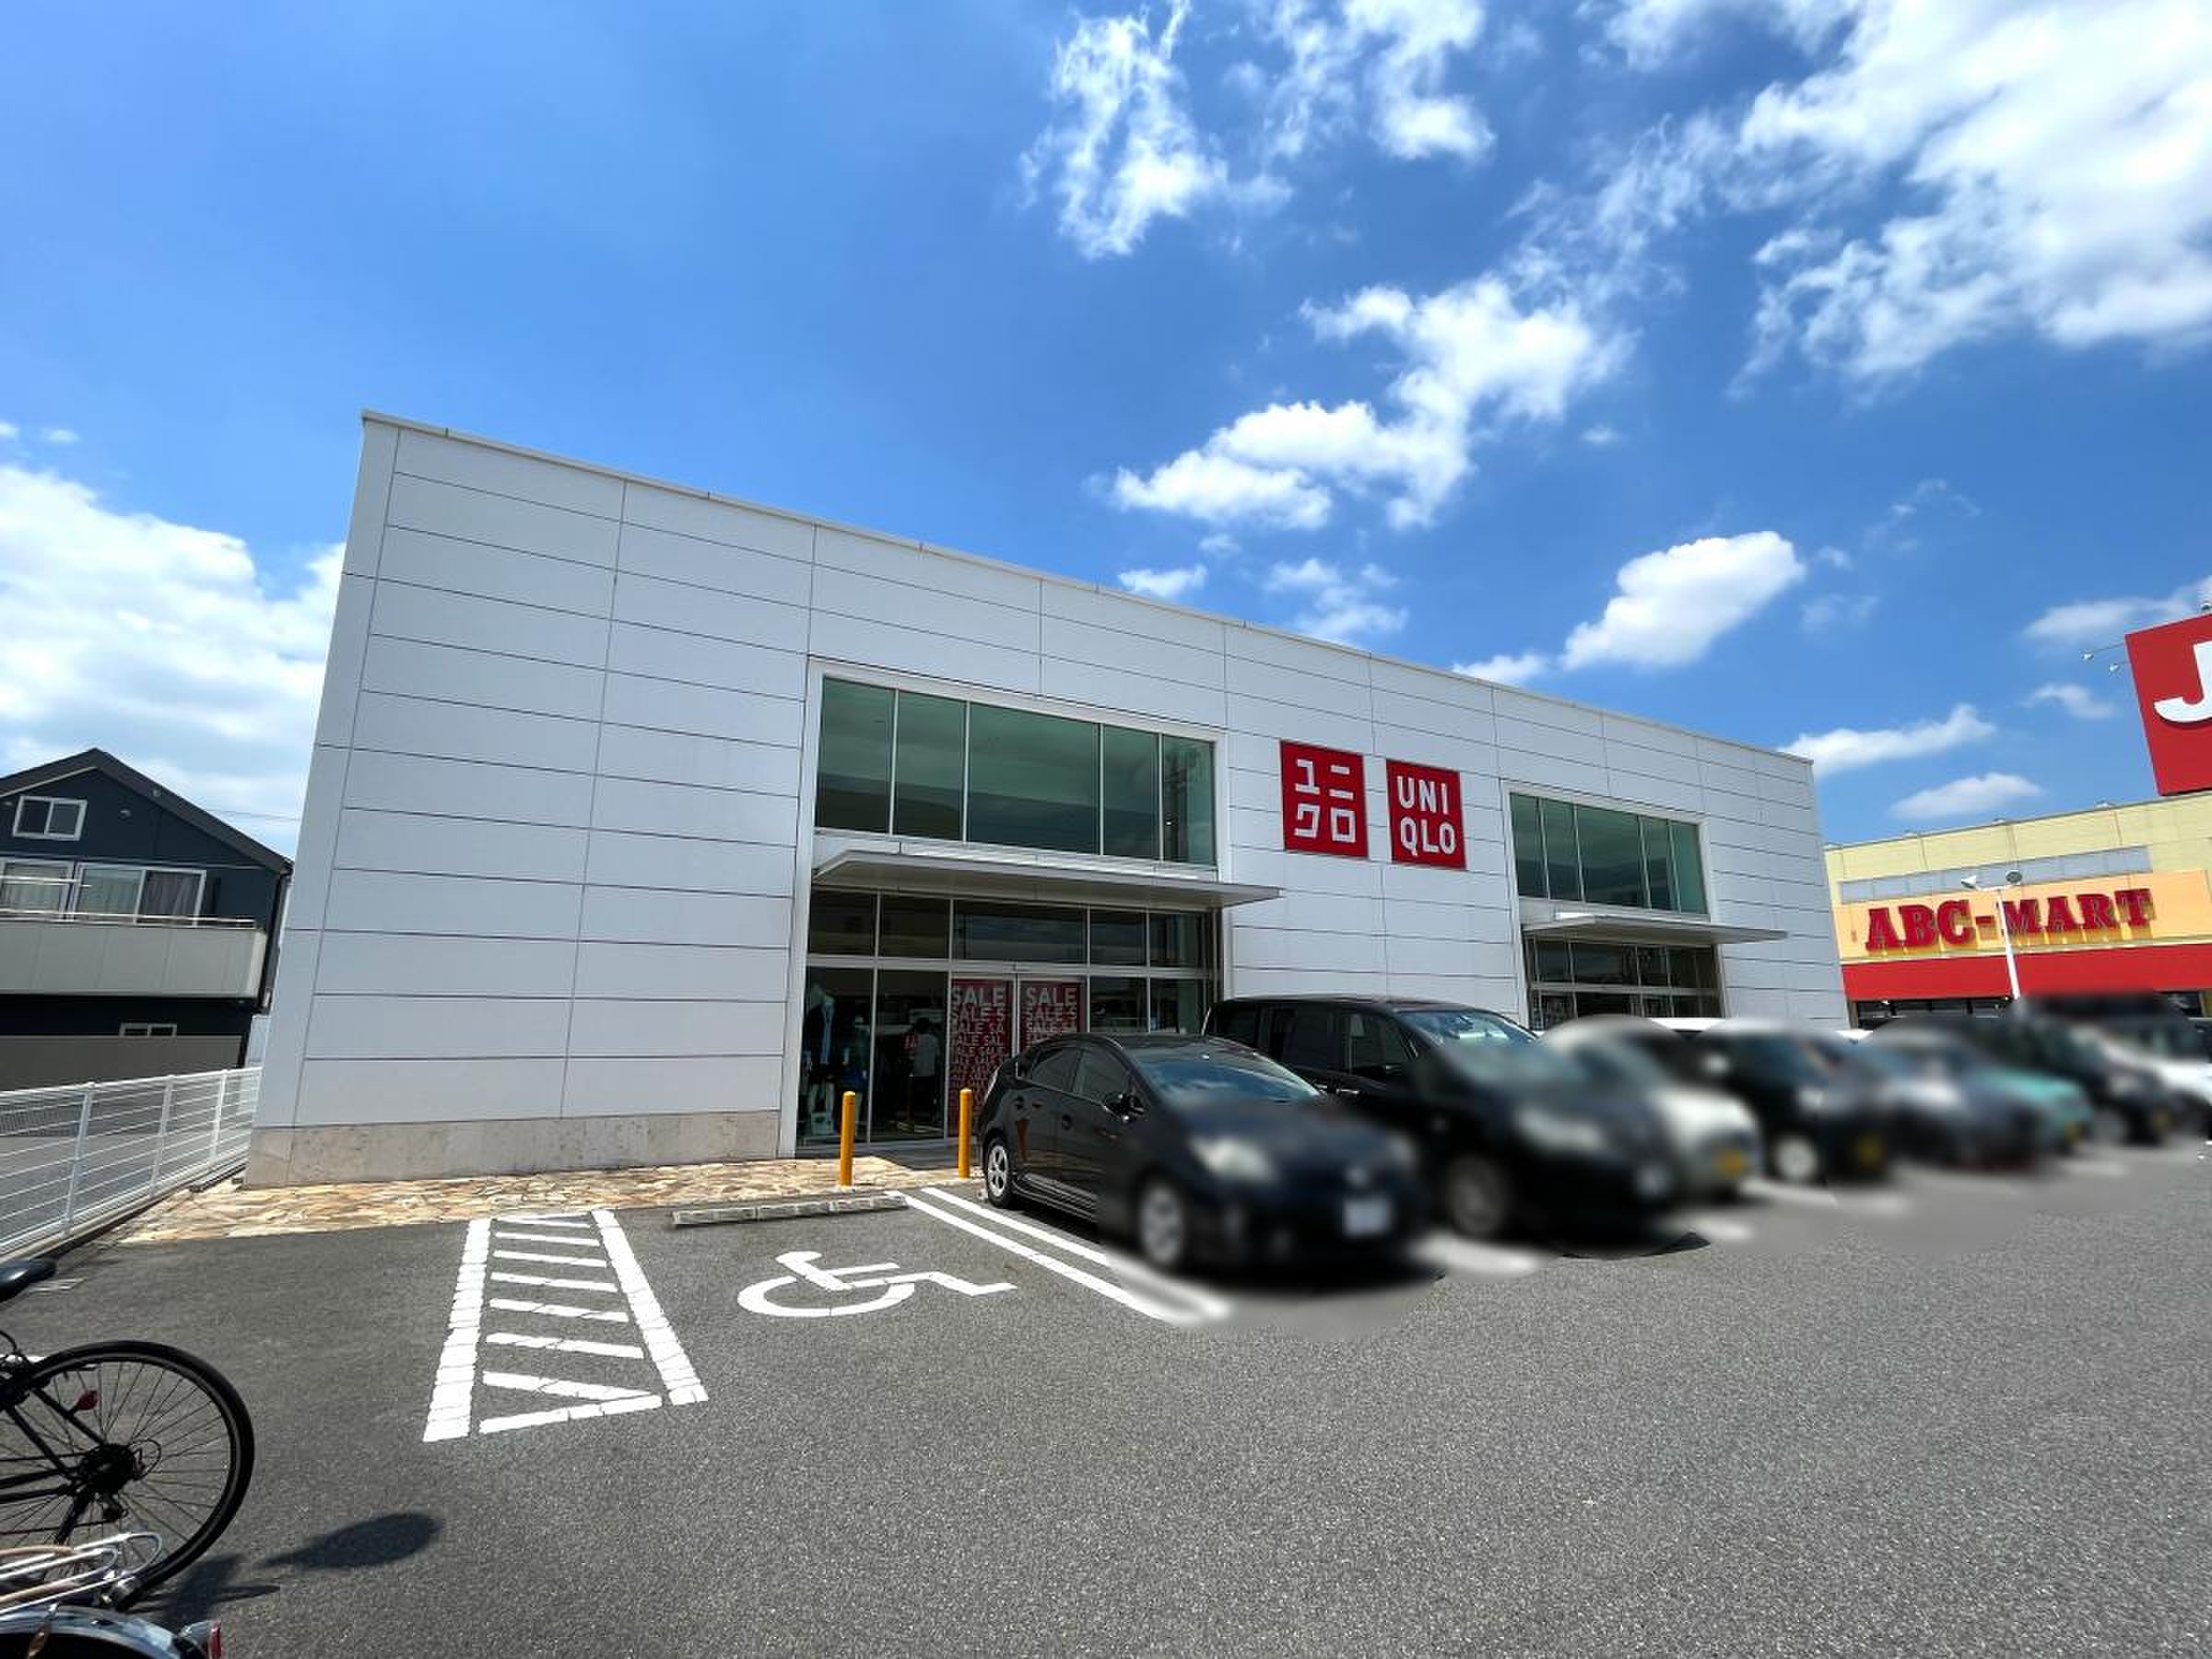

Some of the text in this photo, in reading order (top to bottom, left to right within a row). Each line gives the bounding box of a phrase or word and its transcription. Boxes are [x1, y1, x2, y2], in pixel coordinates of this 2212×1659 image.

[1294, 759, 1355, 801] ユニ
[1396, 775, 1449, 815] UNI
[1294, 803, 1357, 843] クロ
[1400, 817, 1456, 856] QLO
[1865, 888, 2155, 953] ABC-MART
[951, 987, 1005, 1006] SALE
[951, 1005, 990, 1022] SALE
[1026, 987, 1077, 1006] SALE
[1026, 1005, 1063, 1021] SALE
